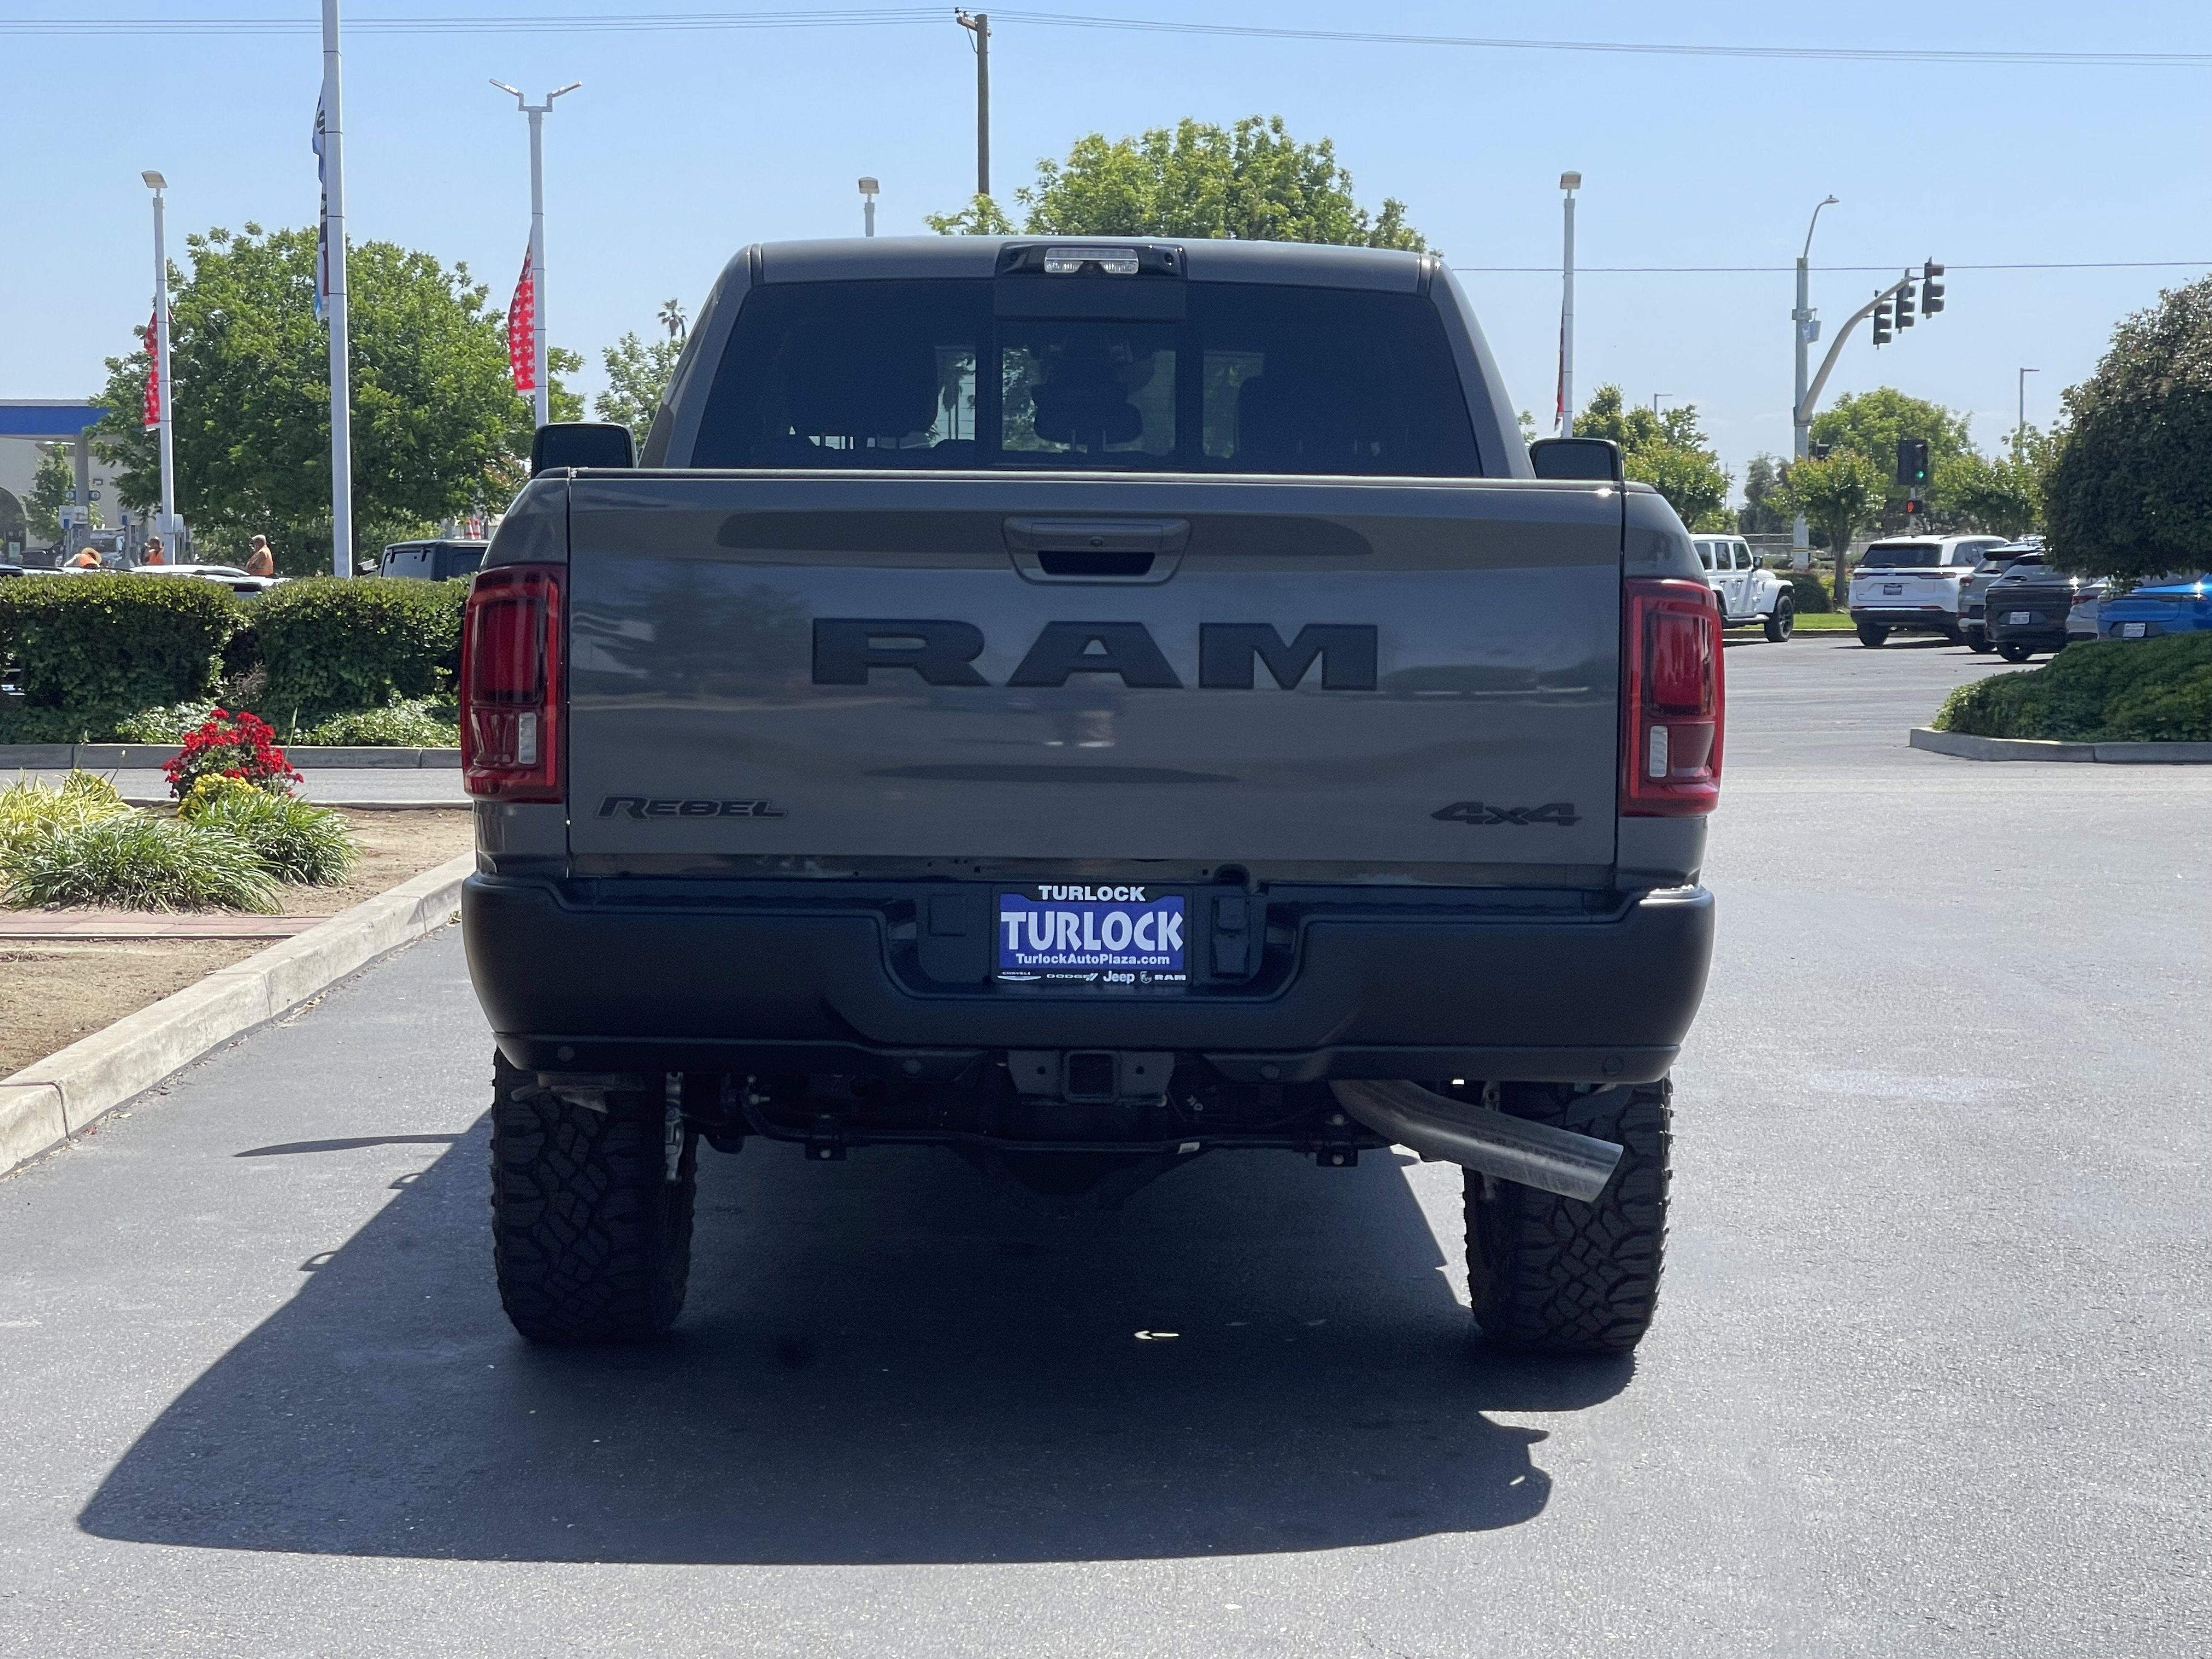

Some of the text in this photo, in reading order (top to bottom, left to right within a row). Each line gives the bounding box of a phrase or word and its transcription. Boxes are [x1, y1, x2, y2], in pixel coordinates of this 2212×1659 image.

[812, 618, 1378, 691] RAM
[596, 796, 787, 820] REBEL
[1039, 885, 1146, 901] TURLOCK
[1001, 911, 1183, 951] TURLOCK
[1015, 953, 1170, 965] TurlockAutoPlaza.com
[1103, 970, 1135, 984] Jeep
